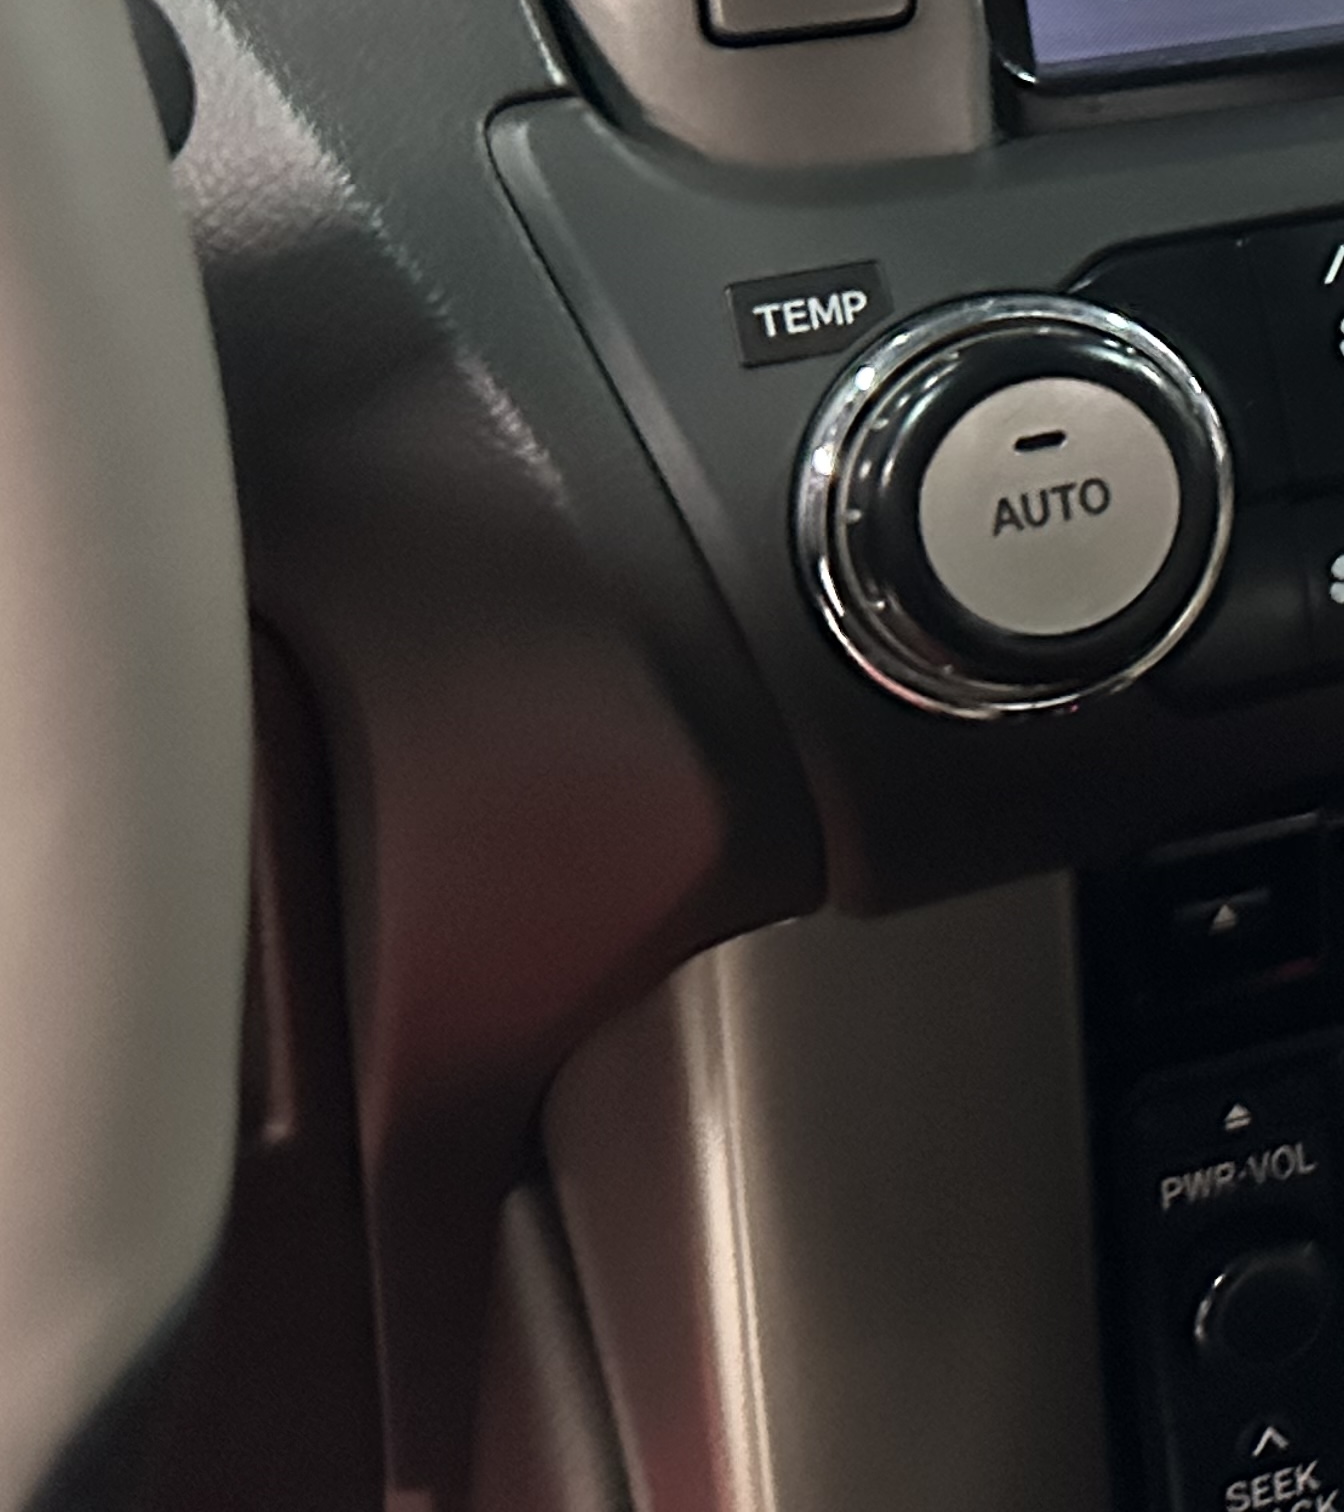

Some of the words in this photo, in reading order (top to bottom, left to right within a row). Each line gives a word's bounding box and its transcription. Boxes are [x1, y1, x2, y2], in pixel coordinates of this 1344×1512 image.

[752, 289, 868, 338] TEMP
[991, 476, 1111, 538] AUTO
[1225, 1458, 1322, 1512] SEEK
